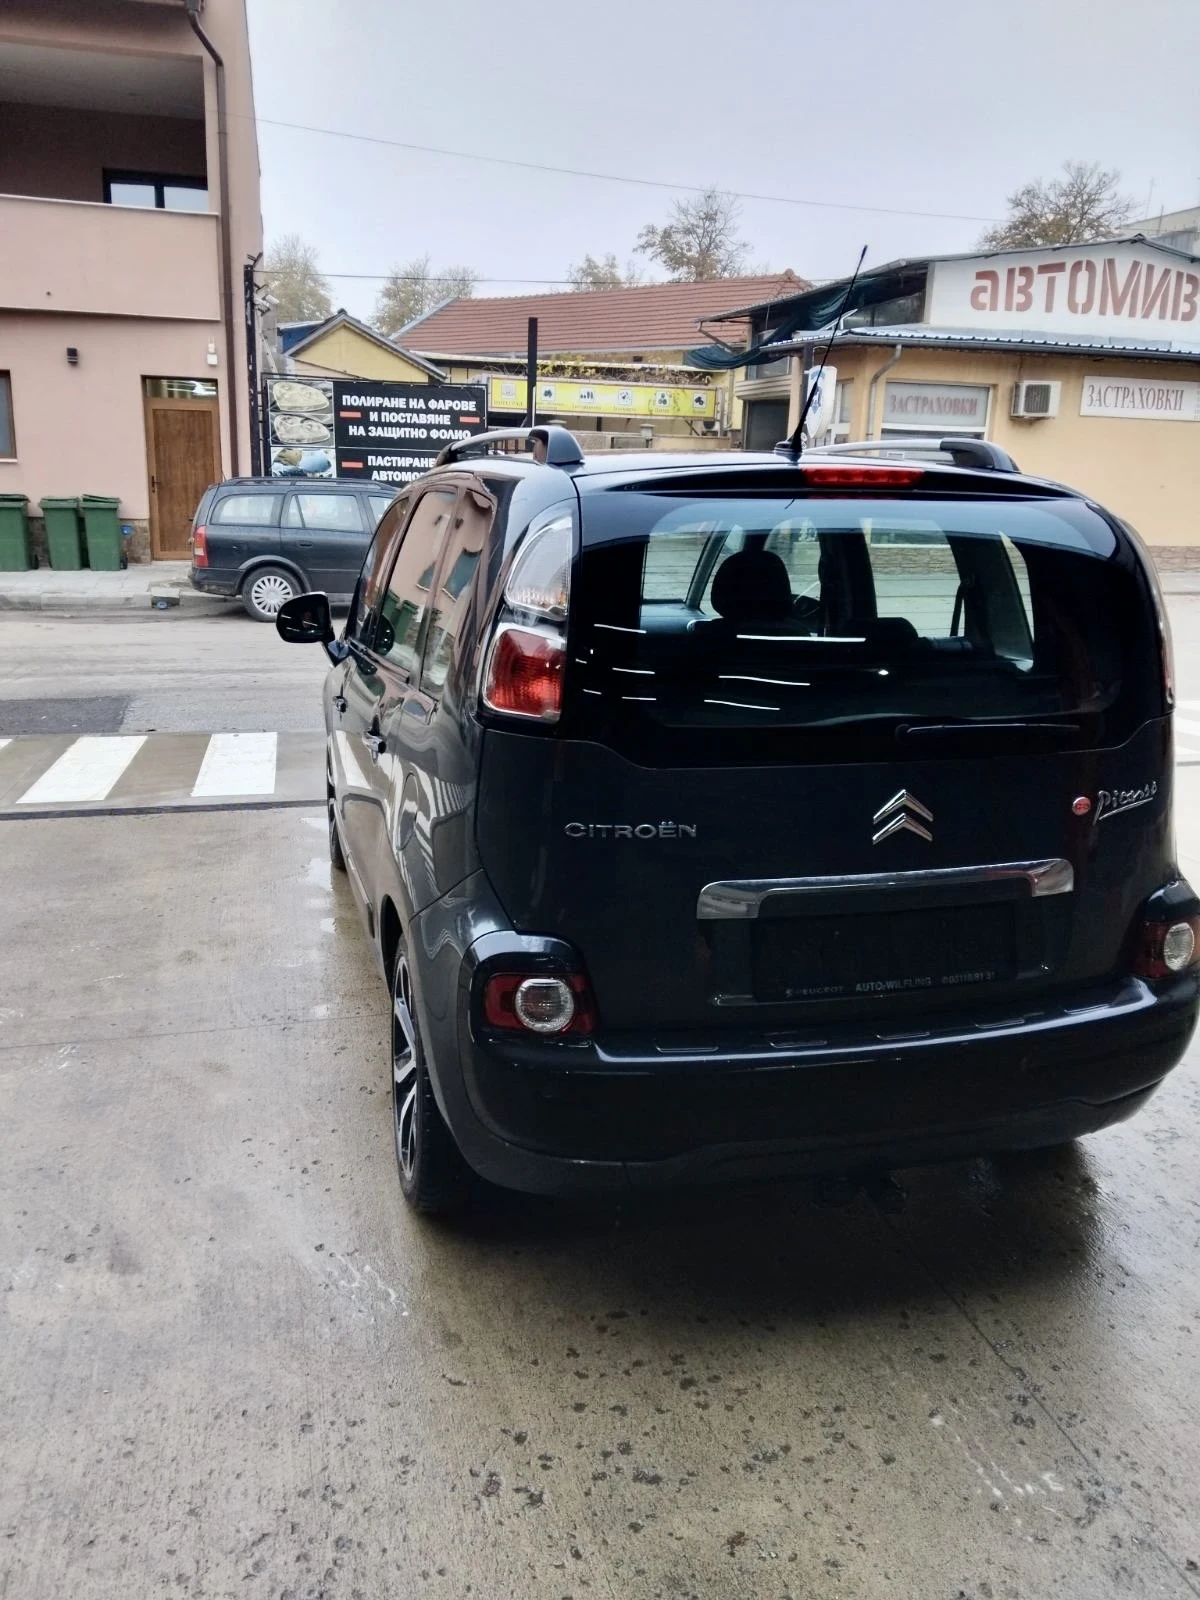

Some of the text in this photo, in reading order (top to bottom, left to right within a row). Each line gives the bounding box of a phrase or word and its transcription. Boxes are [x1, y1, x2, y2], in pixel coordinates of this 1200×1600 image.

[342, 395, 477, 411] ПОЛИРАНЕ НА ФАРОВЕ
[889, 393, 978, 416] ЗАСТРАХОВКИ
[1087, 384, 1185, 411] ЗАСТРАХОВКИ
[369, 411, 451, 425] И ПОСТАВЯНЕ
[349, 426, 471, 441] НА ЗАЩИТНО ФОЛИО
[367, 455, 436, 468] ПАСТИРАНЕ
[371, 470, 424, 482] АВТОМО
[564, 820, 697, 839] CITROËN
